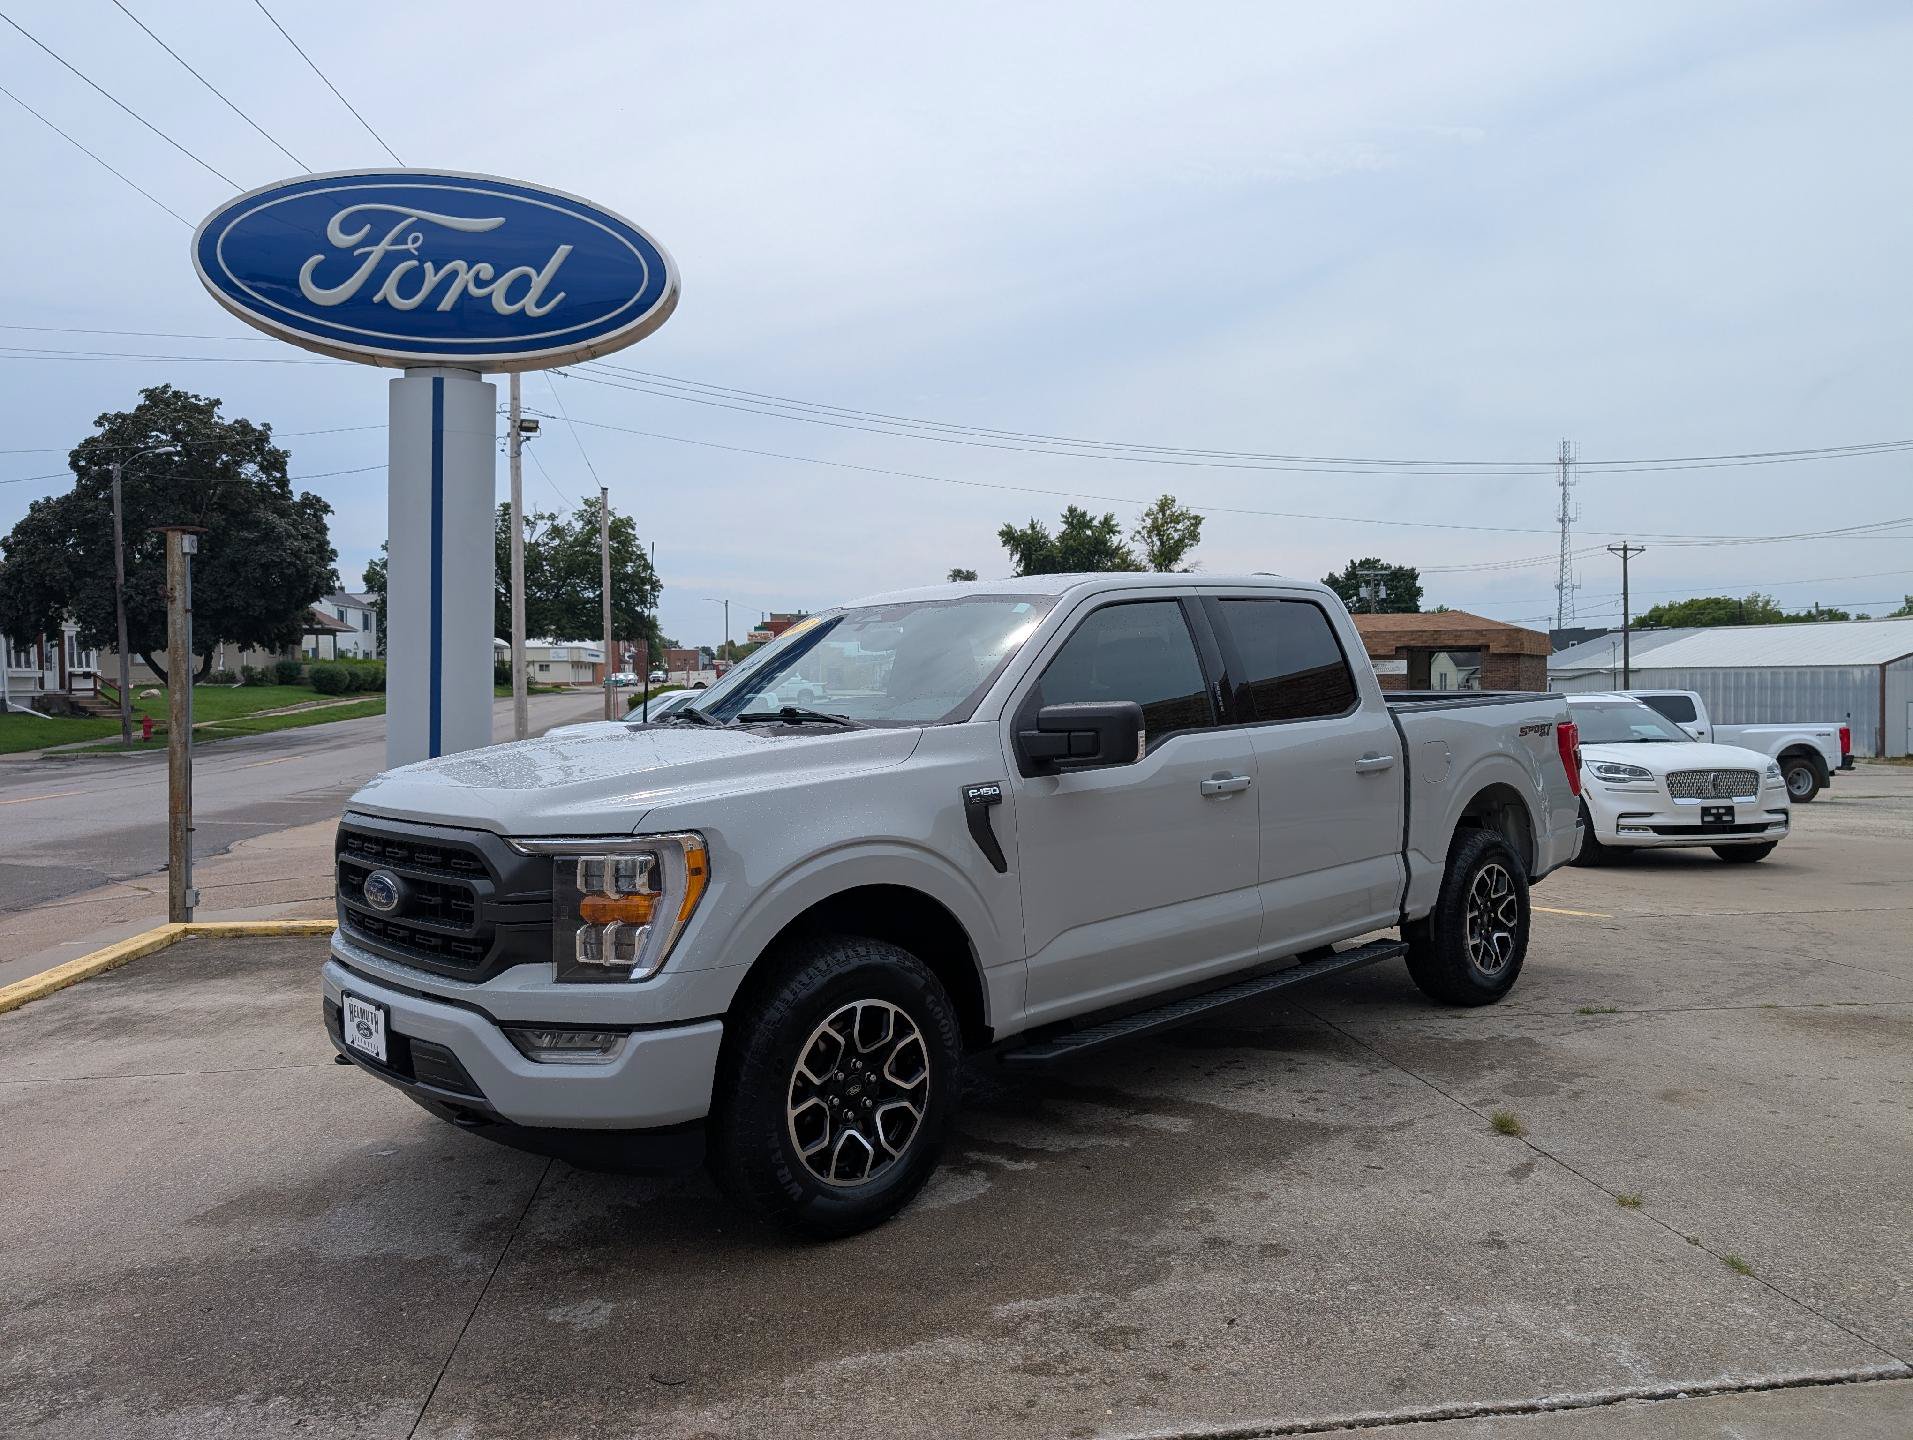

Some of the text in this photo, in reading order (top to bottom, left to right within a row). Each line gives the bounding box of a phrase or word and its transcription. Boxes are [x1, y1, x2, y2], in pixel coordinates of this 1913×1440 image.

[299, 203, 574, 318] Ford
[1519, 722, 1552, 737] SPORT
[969, 787, 1000, 797] F-150
[348, 1002, 379, 1034] HELMUTH
